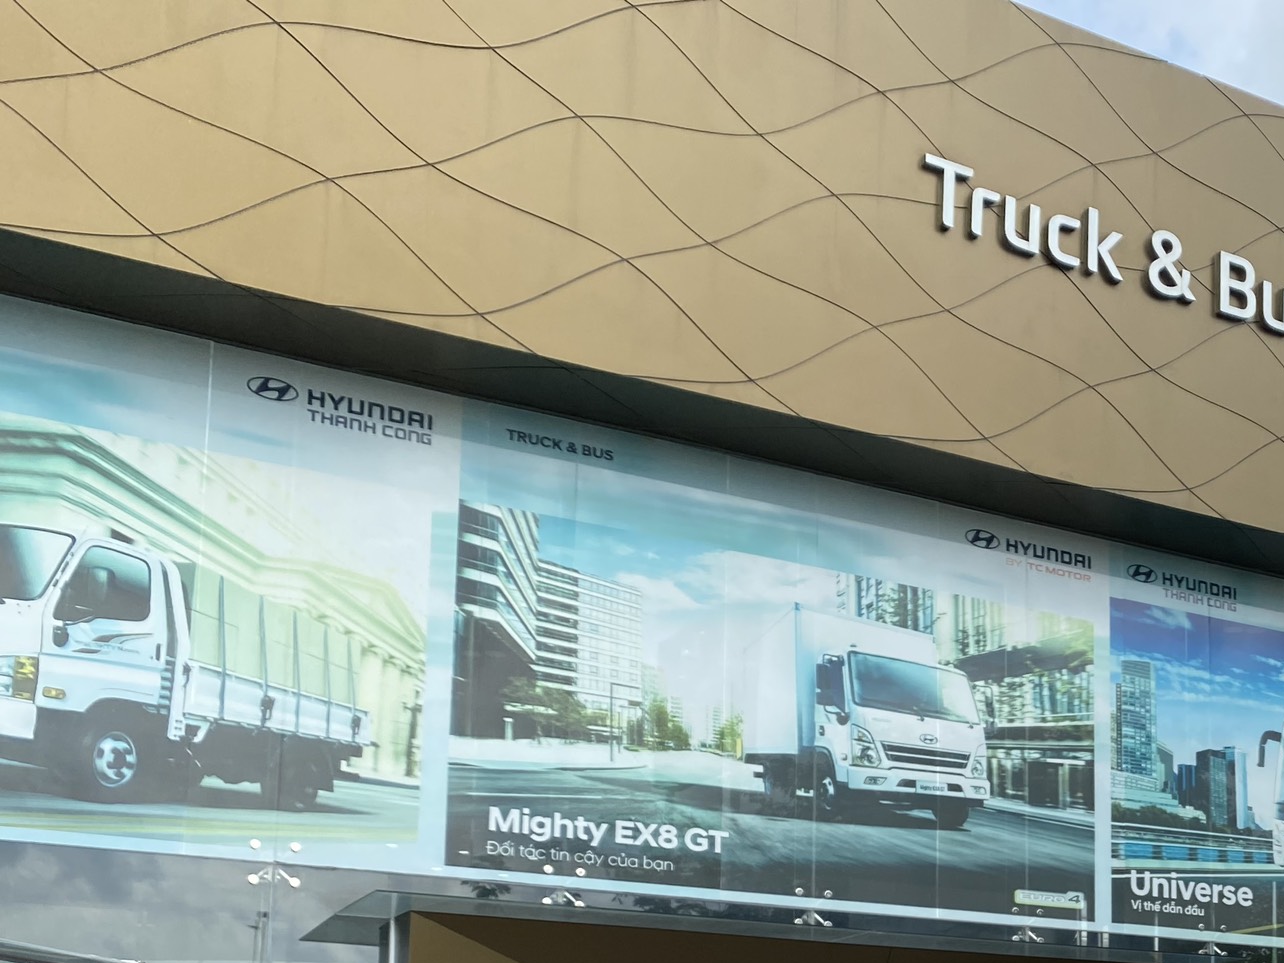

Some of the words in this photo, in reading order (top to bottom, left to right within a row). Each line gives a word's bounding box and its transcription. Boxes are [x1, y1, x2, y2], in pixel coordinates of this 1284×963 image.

[922, 152, 1124, 284] Truck
[1146, 229, 1197, 303] &
[307, 388, 433, 431] HYUNDAI
[307, 408, 376, 434] THANH
[382, 424, 432, 446] CONG
[506, 428, 562, 451] TRUCK
[566, 441, 578, 454] &
[581, 444, 614, 461] BUS
[1005, 538, 1092, 569] HYUNDAI
[1006, 557, 1022, 567] BY
[1027, 561, 1044, 573] TC
[1045, 566, 1092, 582] MOTOR
[1162, 572, 1237, 600] HYUNDAI
[1162, 587, 1204, 606] THANH
[1207, 597, 1237, 612] CONG
[488, 806, 608, 847] Mighty
[615, 820, 678, 849] EX8
[684, 827, 730, 853] GT
[485, 840, 514, 857] Đối
[550, 847, 570, 861] tin
[574, 850, 603, 866] cậy
[608, 852, 638, 867] của
[643, 856, 674, 871] bạn
[1130, 869, 1253, 907] Universe
[1131, 899, 1142, 912] Vị
[1143, 900, 1161, 912] thế
